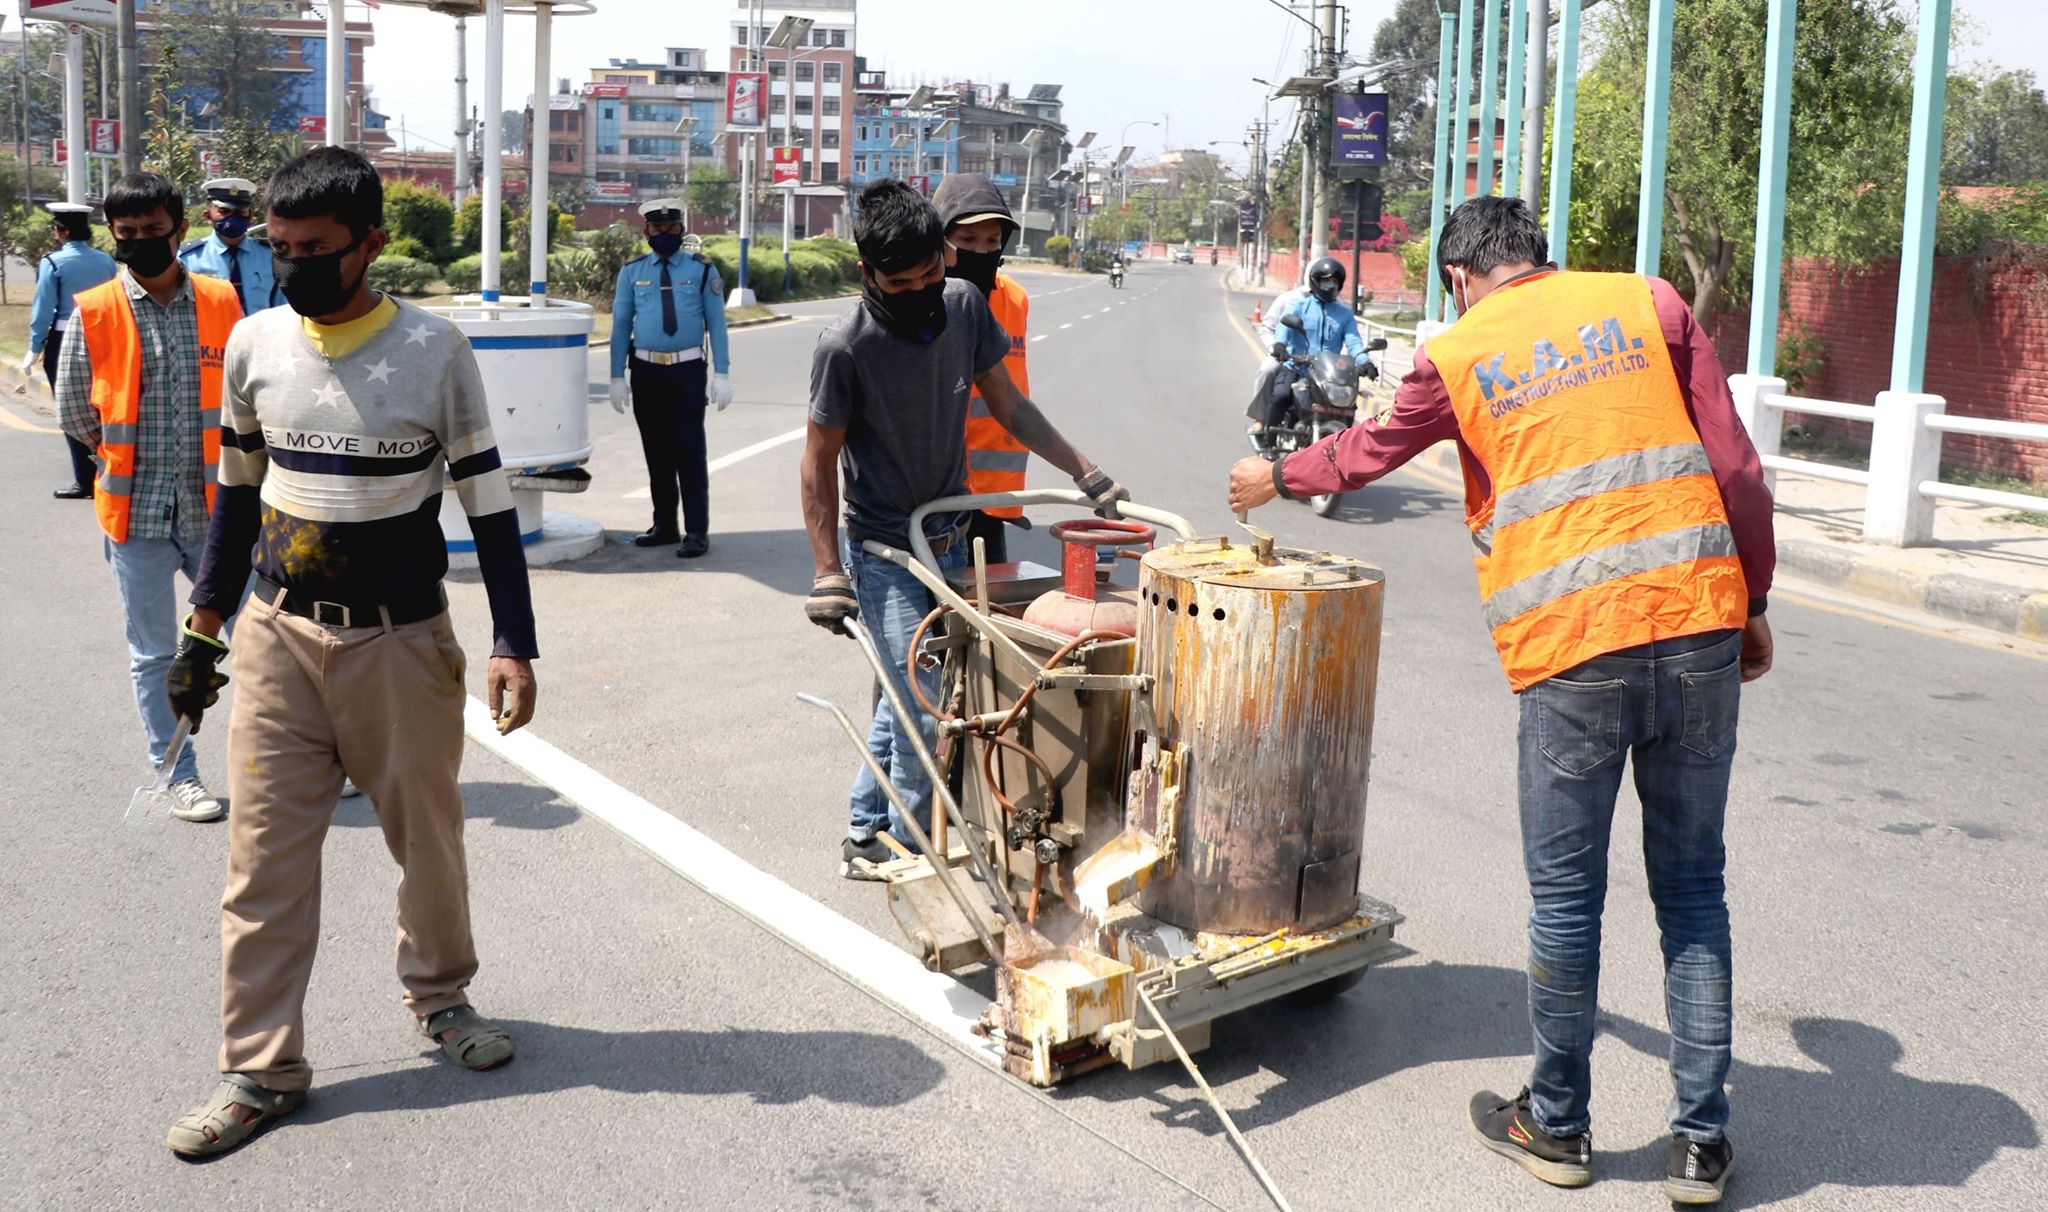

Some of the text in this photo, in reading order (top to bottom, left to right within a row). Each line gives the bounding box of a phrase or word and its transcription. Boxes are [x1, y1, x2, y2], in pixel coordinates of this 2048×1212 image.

[1474, 317, 1644, 401] K.A.M.
[1489, 368, 1589, 419] CONSTRUCTION
[1590, 360, 1620, 381] PVT.
[286, 432, 360, 453] MOVE
